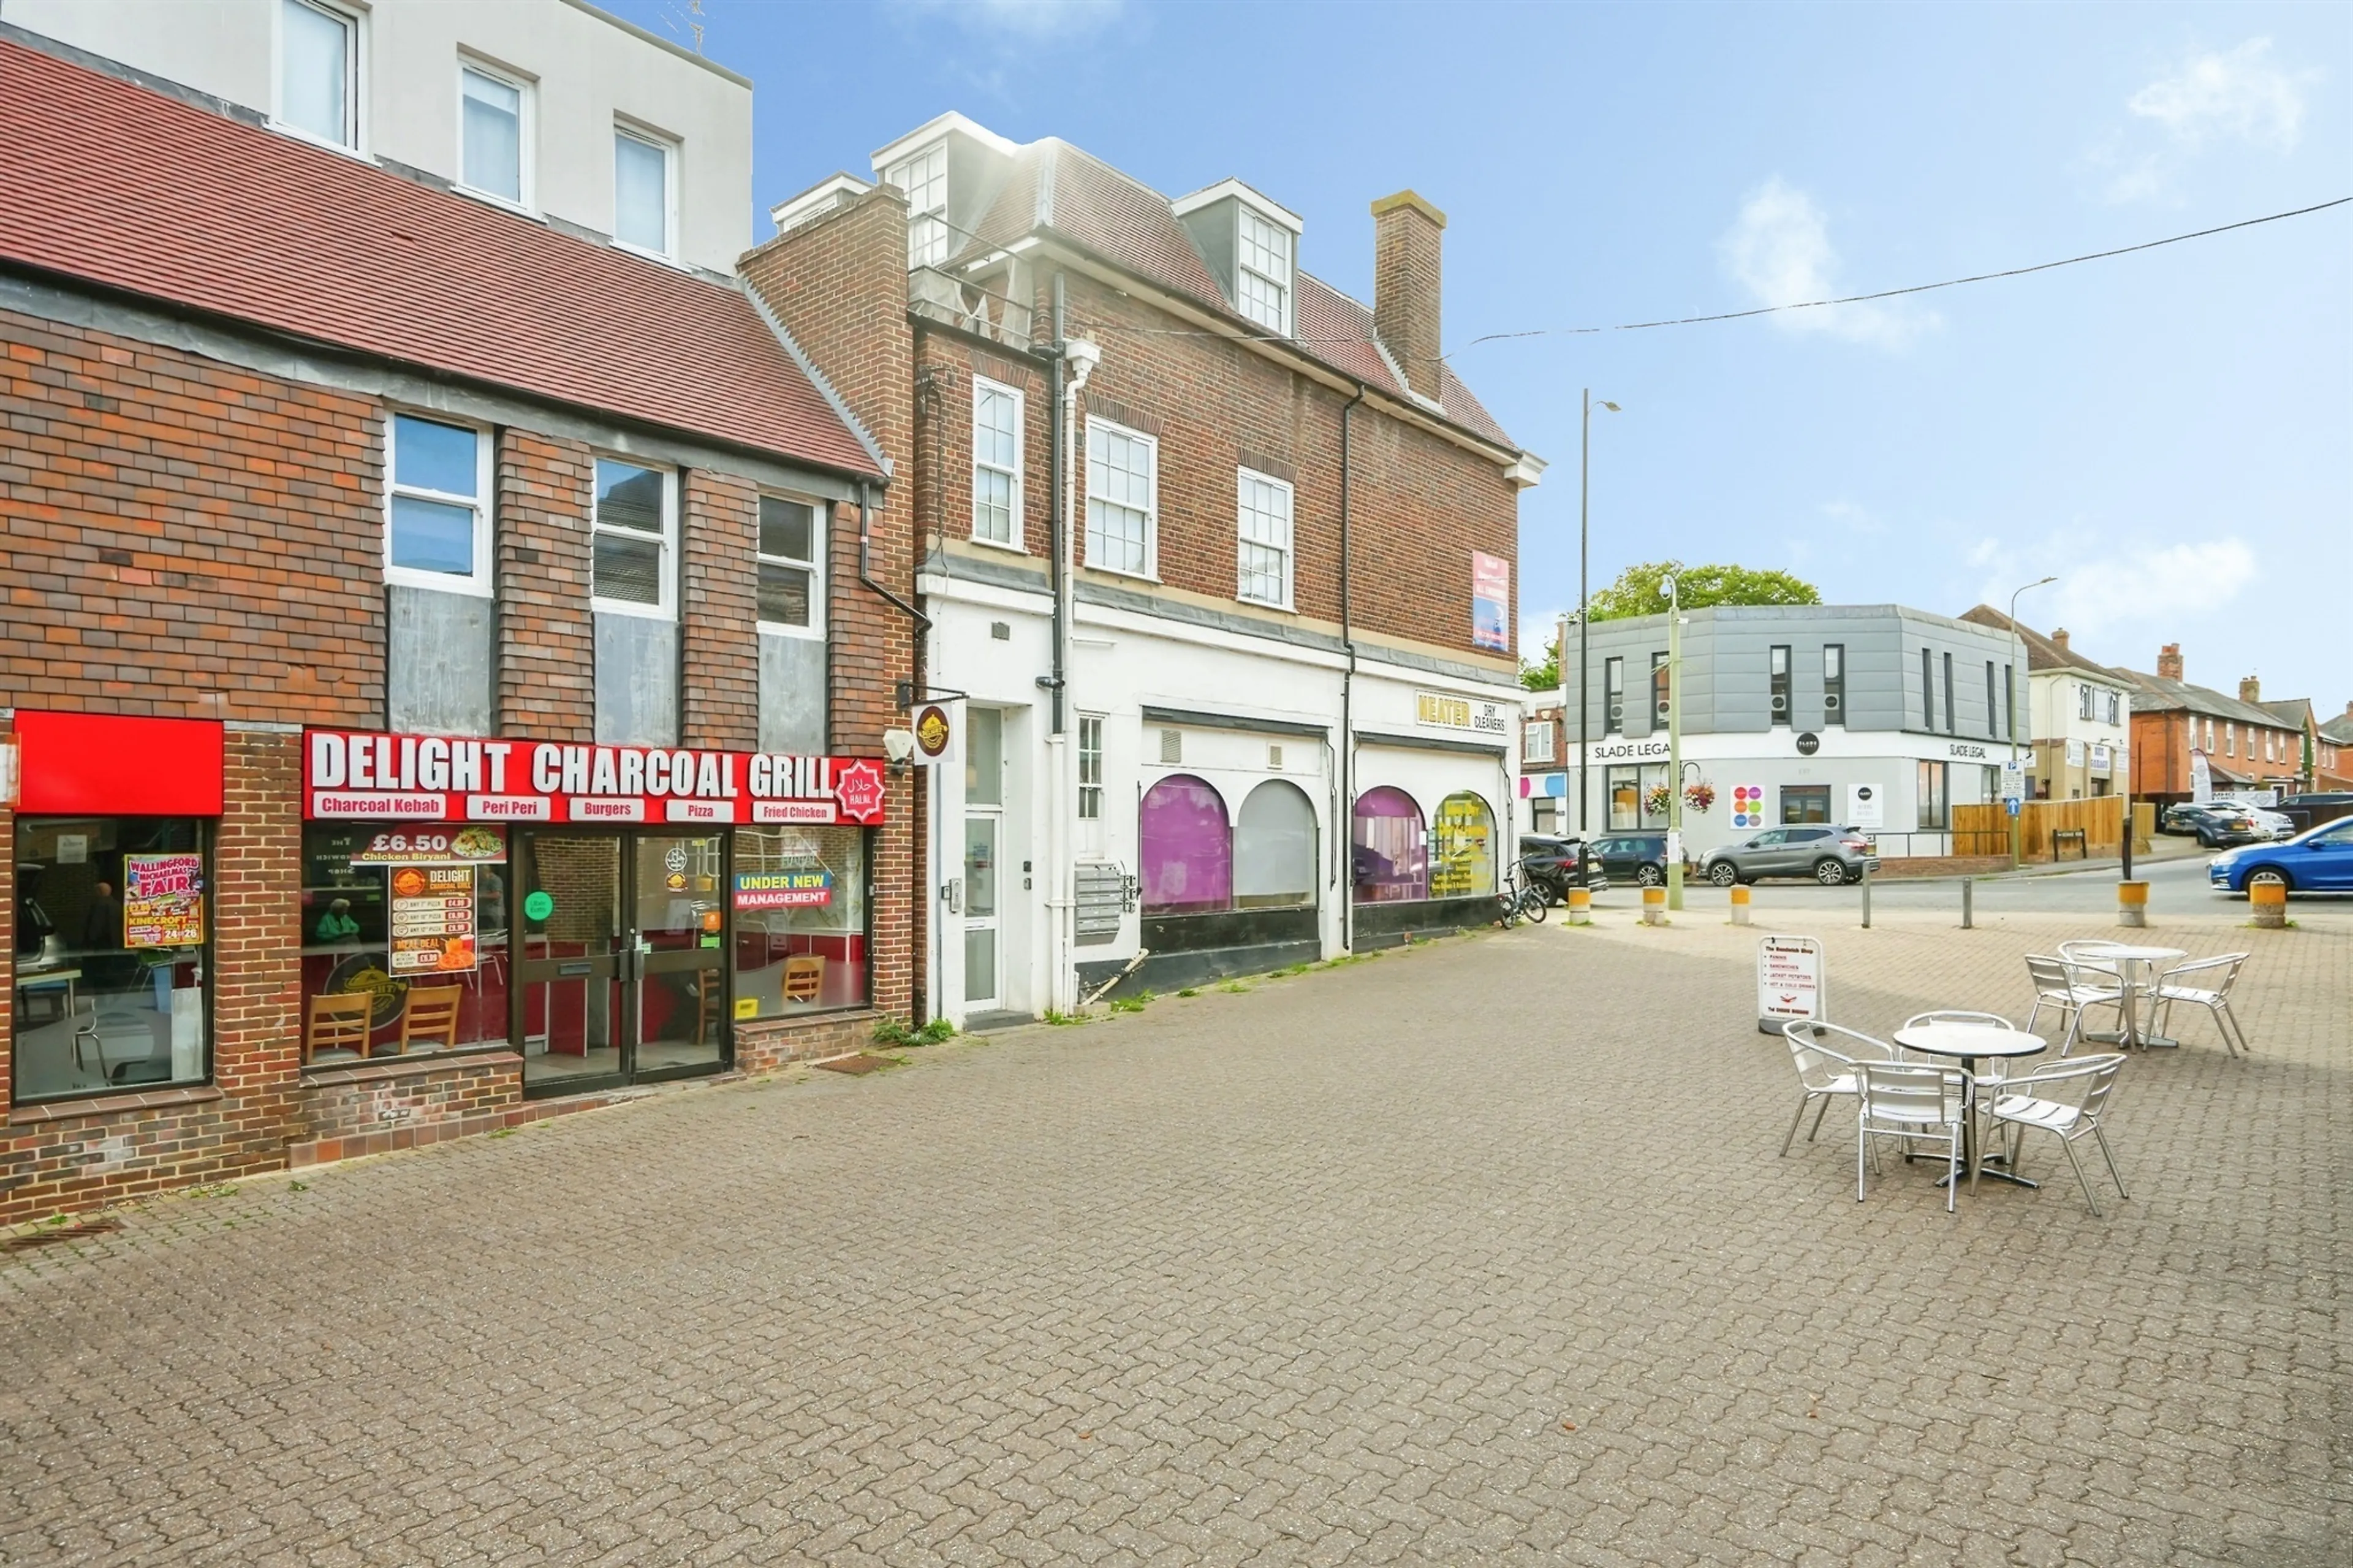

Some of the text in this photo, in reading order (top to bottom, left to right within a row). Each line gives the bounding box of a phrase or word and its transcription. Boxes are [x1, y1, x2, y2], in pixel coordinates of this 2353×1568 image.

[1418, 695, 1471, 727] NEATER
[1484, 704, 1496, 717] DRY
[1474, 716, 1505, 731] CLEANERS
[1594, 743, 1671, 758] SLADE LEGA
[1950, 744, 1986, 758] SLADE LEGAL
[311, 733, 835, 798] DELIGHT CHARCOAL GRILL
[847, 779, 873, 793] حلال
[322, 798, 439, 812] Charcoal Kebab
[482, 800, 537, 814] Peri Peri
[850, 795, 872, 805] HALAL
[585, 803, 632, 816] Burgers
[688, 805, 714, 817] Pizza
[763, 806, 827, 818] Fried Chicken
[373, 835, 447, 851] £6.50
[412, 853, 450, 862] Biryani
[129, 858, 199, 873] WALLINGFORD
[430, 870, 471, 882] DELIGHT
[740, 875, 824, 890] UNDER NEW
[140, 876, 189, 897] FAIR
[737, 892, 827, 905] MANAGEMENT
[129, 917, 187, 925] KINECROFT
[184, 929, 197, 938] 26
[396, 938, 439, 949] MEAL DEAL
